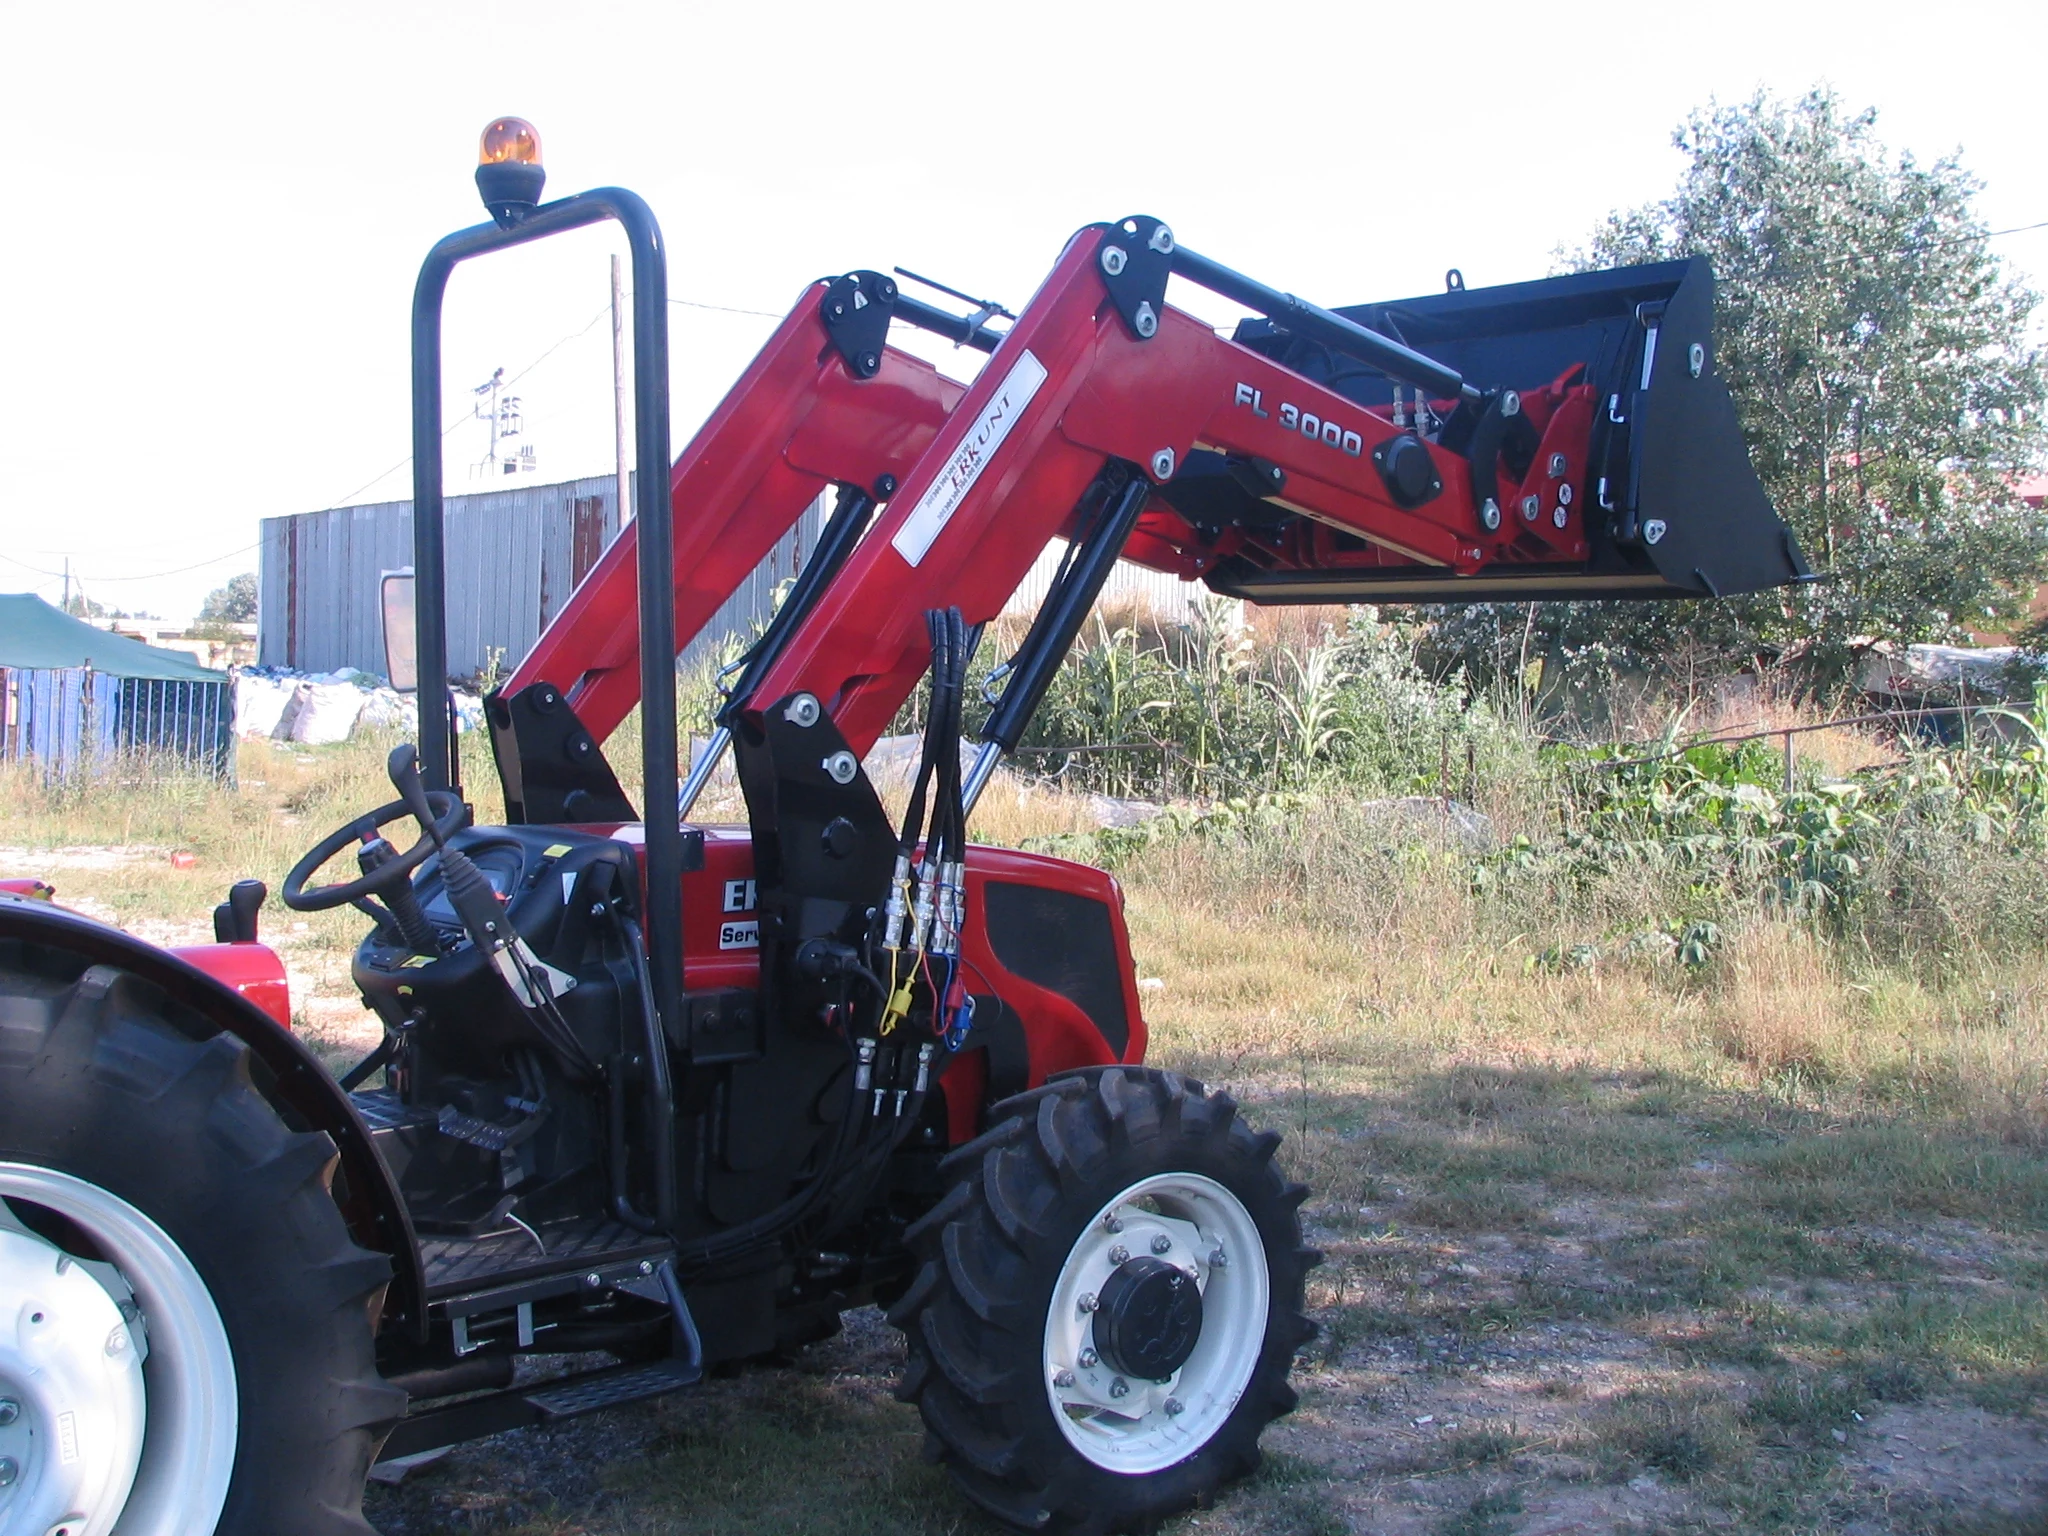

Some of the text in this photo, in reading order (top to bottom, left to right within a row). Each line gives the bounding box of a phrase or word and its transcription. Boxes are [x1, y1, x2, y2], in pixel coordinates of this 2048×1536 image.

[950, 391, 1011, 491] ERKUNT
[1234, 382, 1363, 457] FL 3000
